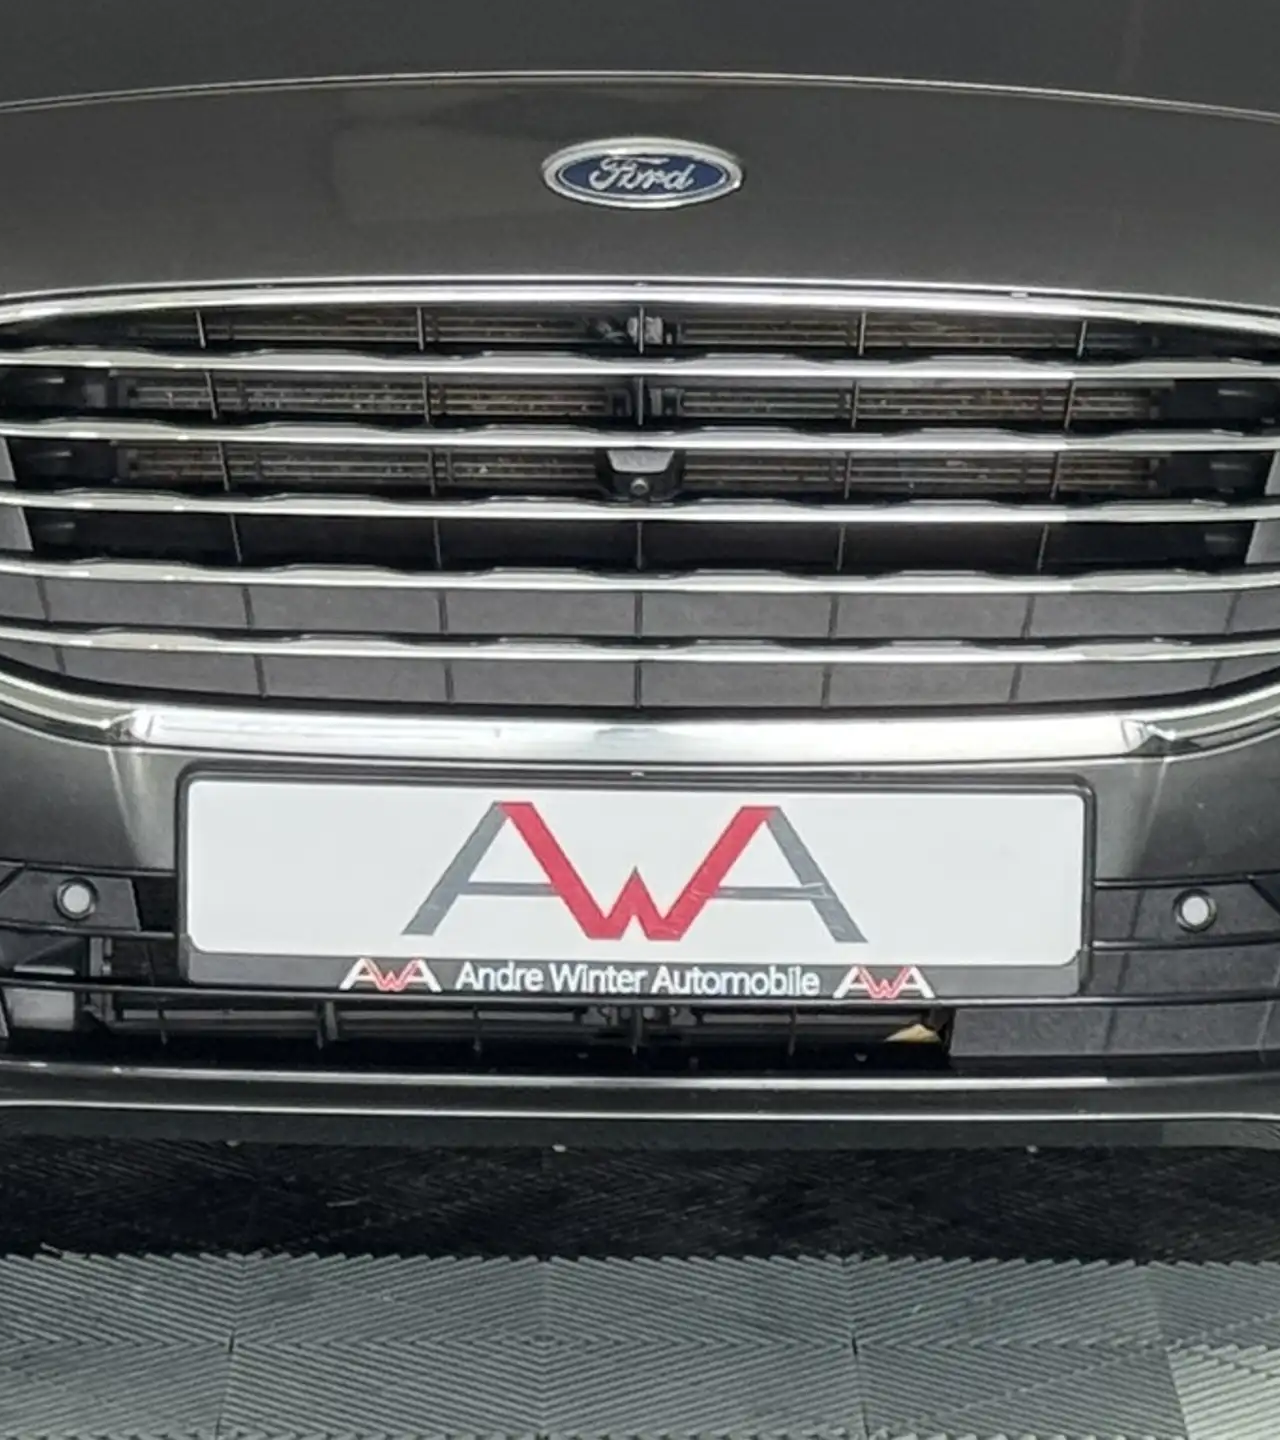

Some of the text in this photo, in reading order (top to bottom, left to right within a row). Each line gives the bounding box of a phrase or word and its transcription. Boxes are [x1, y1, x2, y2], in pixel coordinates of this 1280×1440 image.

[588, 156, 695, 190] Ford
[455, 961, 544, 991] Andre
[549, 962, 648, 993] Winter
[651, 964, 819, 995] Automobile
